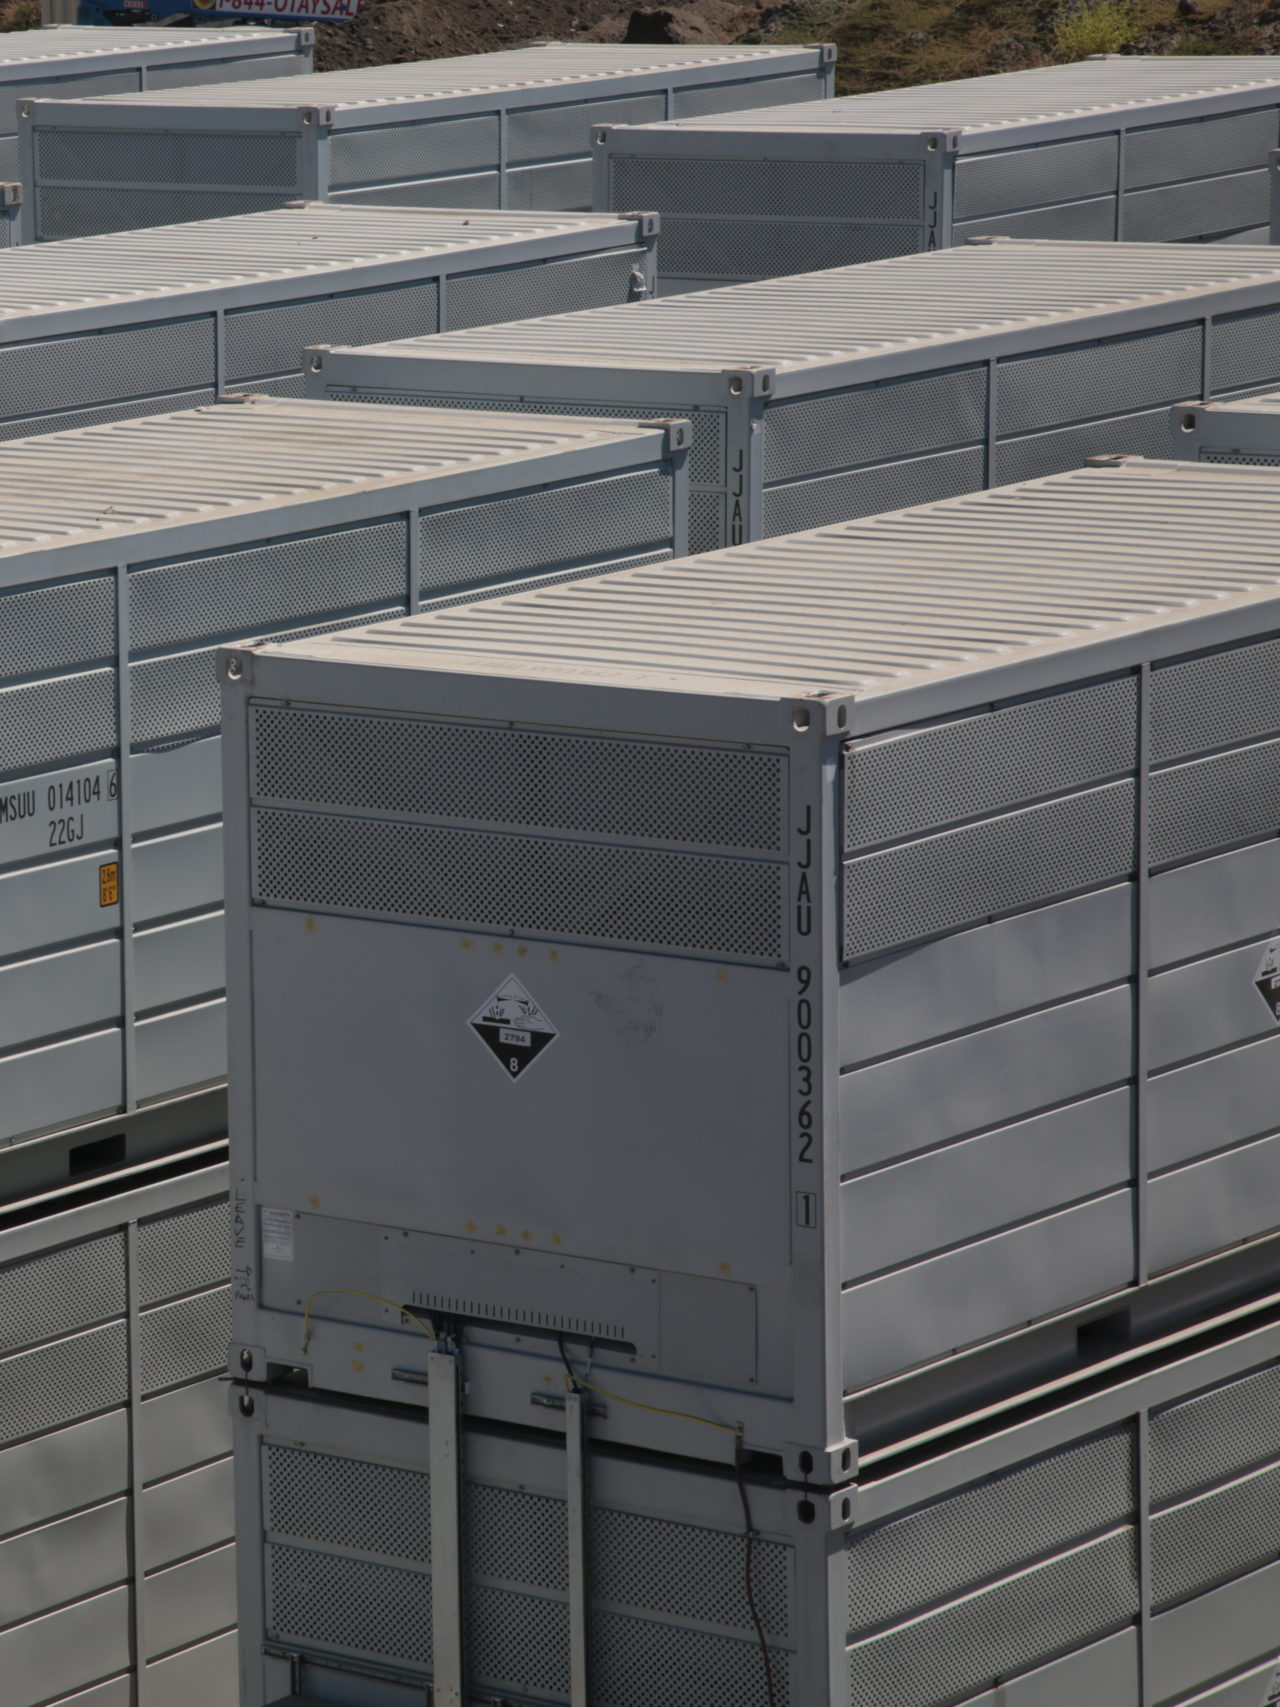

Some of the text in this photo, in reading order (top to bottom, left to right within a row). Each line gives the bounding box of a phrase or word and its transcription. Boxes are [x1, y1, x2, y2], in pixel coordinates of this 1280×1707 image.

[928, 192, 937, 251] JJA
[732, 449, 743, 545] JJAU
[47, 775, 101, 811] 014104
[108, 771, 118, 799] 6
[48, 814, 84, 847] 22GJ
[797, 805, 812, 936] JJAU
[503, 1033, 526, 1043] 2794
[510, 1057, 519, 1072] 8
[797, 965, 813, 1164] 900362
